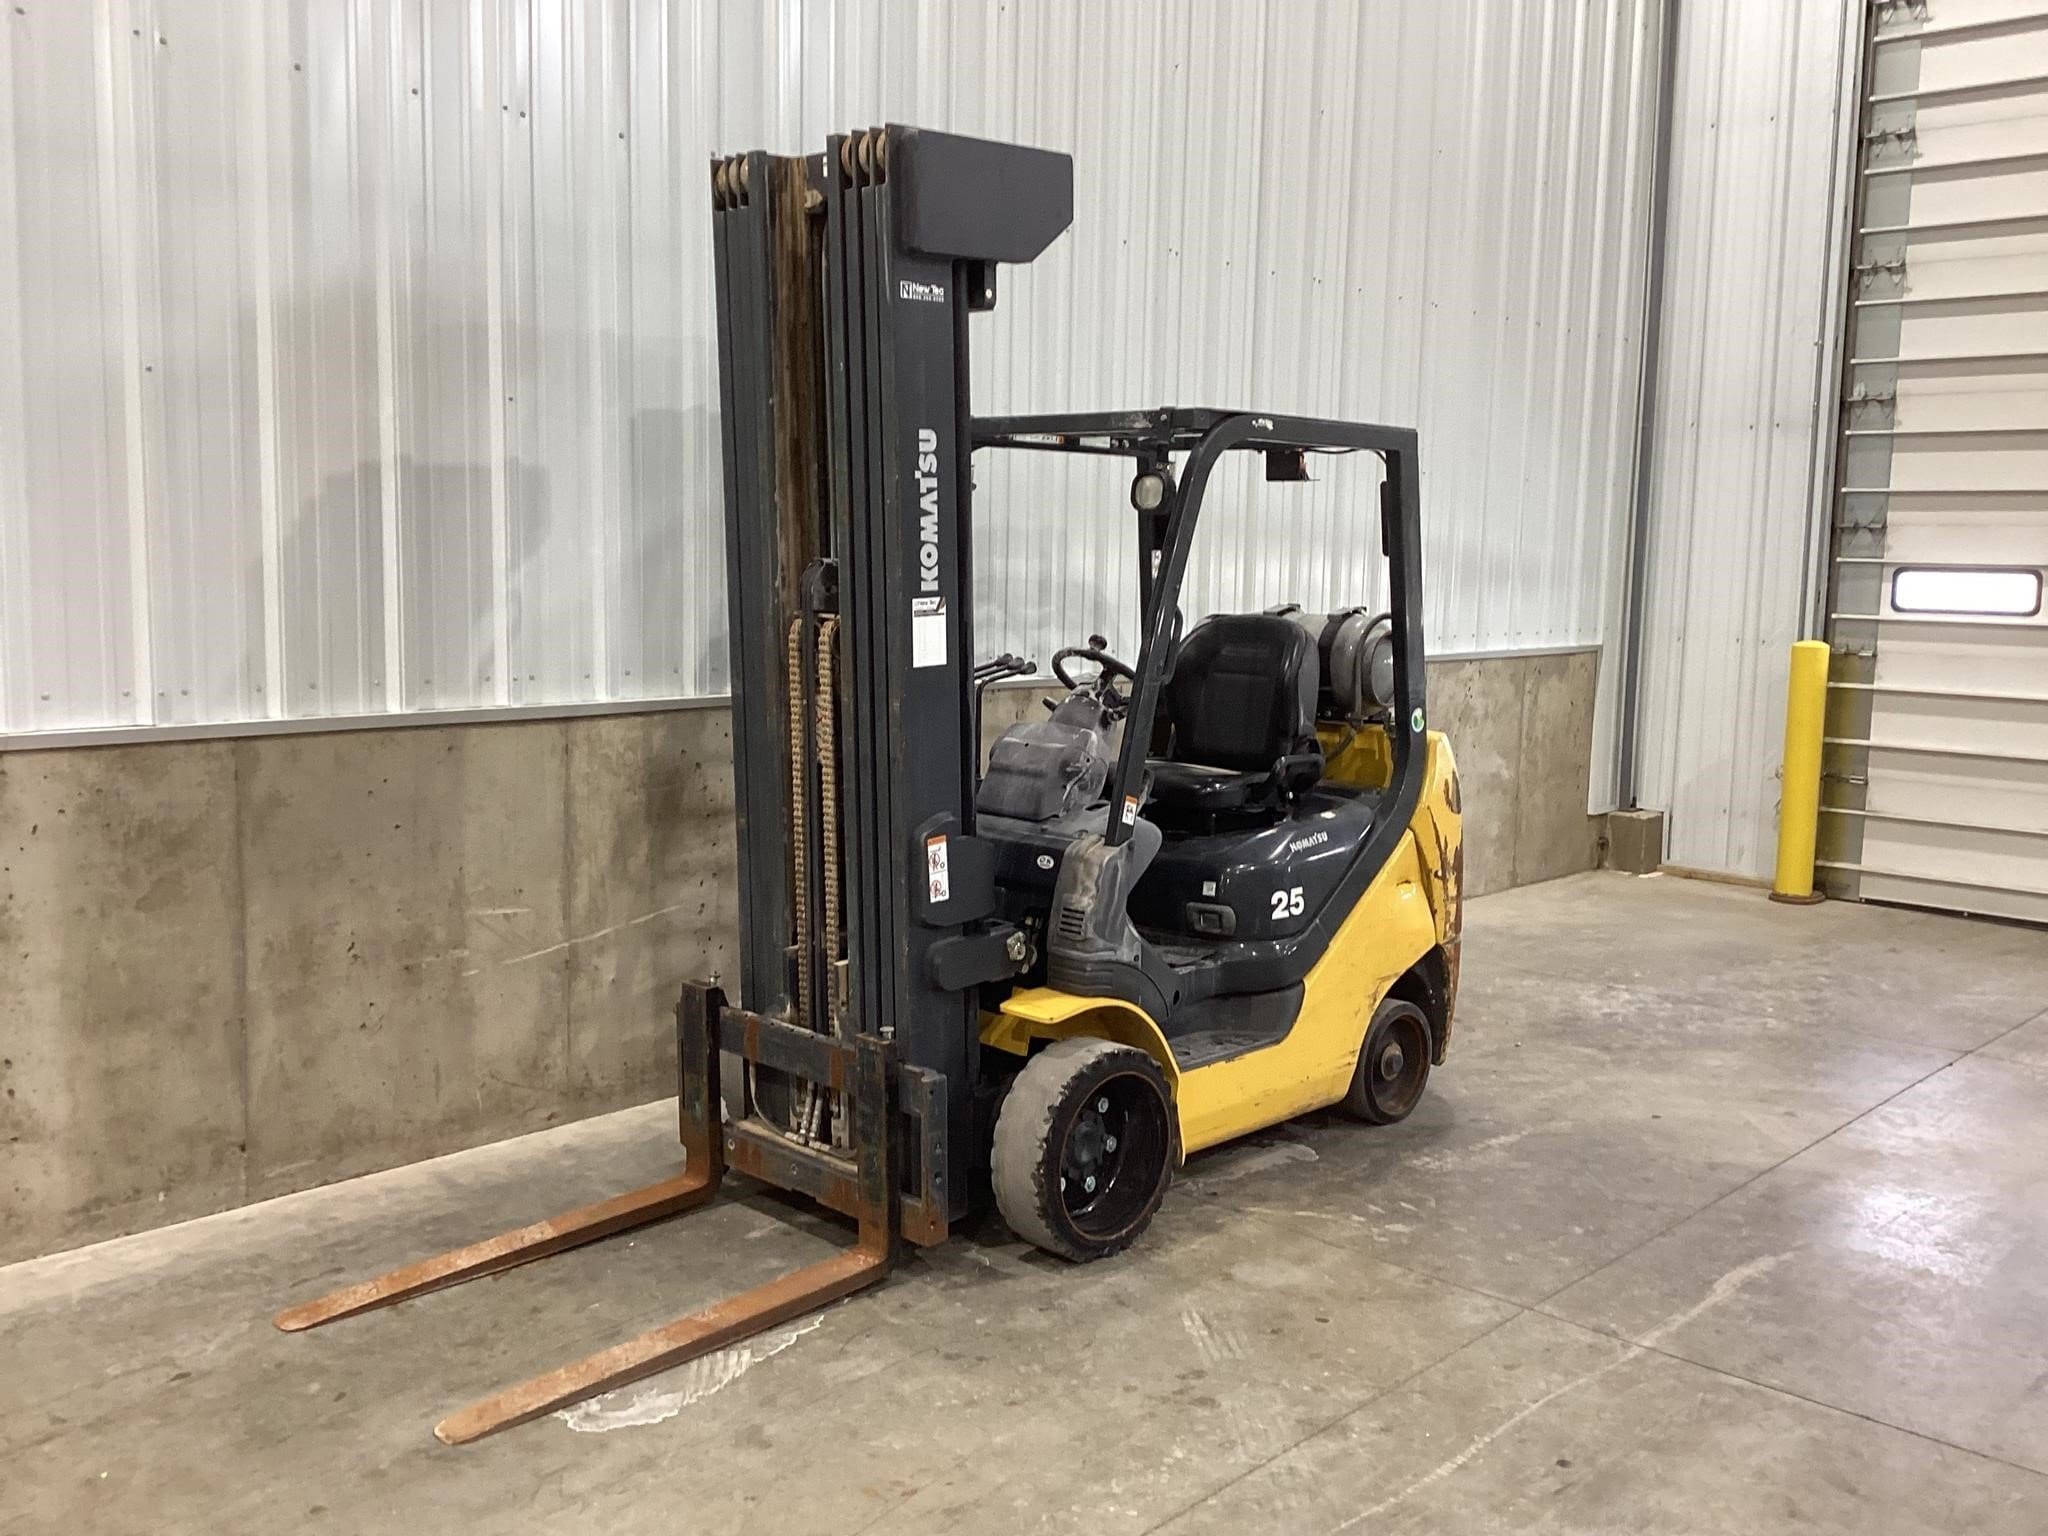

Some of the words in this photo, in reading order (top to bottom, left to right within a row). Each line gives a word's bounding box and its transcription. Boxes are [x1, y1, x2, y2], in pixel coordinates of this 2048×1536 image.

[914, 428, 939, 592] KOMATSU
[1290, 831, 1328, 852] KOMATSU
[1270, 886, 1305, 920] 25
